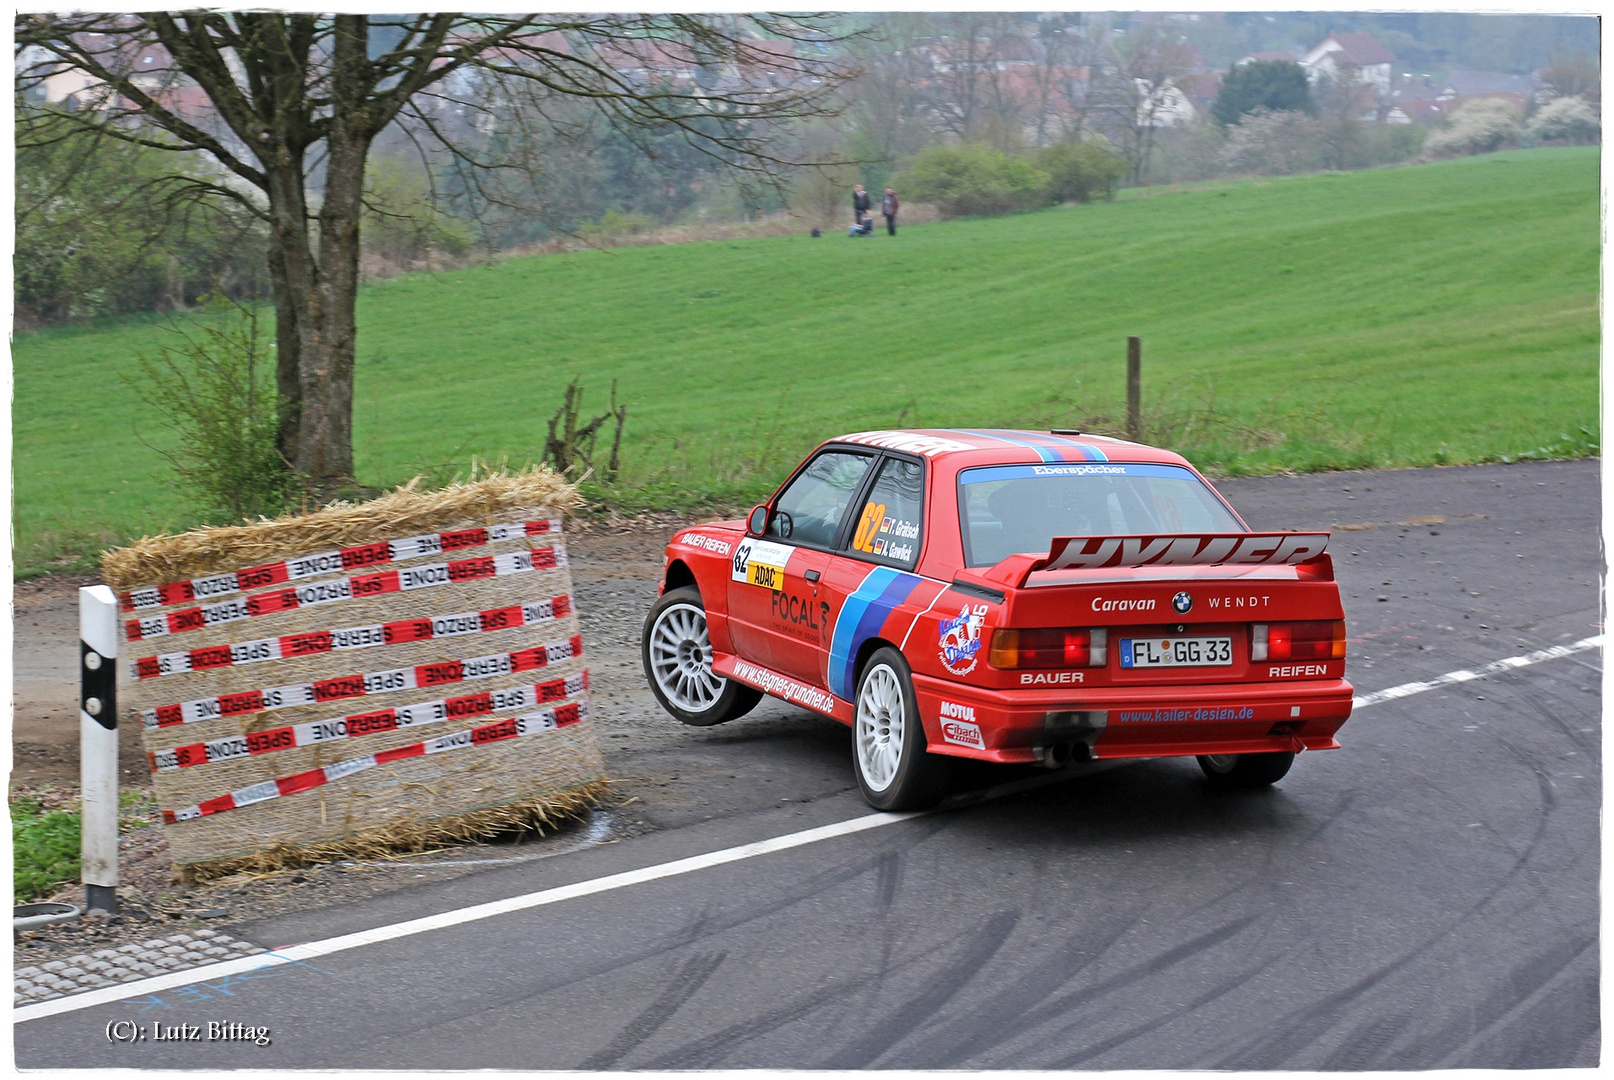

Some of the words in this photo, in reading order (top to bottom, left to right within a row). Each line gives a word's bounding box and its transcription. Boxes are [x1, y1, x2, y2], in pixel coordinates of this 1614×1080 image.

[1032, 465, 1127, 476] Eberspächer
[853, 502, 886, 554] 62
[681, 533, 706, 547] BAUER
[703, 538, 731, 555] REIFEN
[1046, 534, 1330, 569] HYMER
[293, 544, 396, 575] SPERRZONE
[733, 545, 751, 574] 62
[181, 573, 274, 598] SPERRZONE
[754, 565, 775, 587] ADAC
[282, 577, 384, 607] SPERRZONE
[1092, 597, 1156, 612] Caravan
[1209, 596, 1270, 608] WENDT
[176, 599, 260, 629] SPERRZONE
[772, 590, 818, 629] FOCAL
[413, 611, 508, 637] SPERRZONE
[291, 627, 393, 652] SPERRZONE
[1133, 643, 1160, 664] FL
[1174, 641, 1201, 662] GG
[1206, 640, 1230, 662] 33
[184, 643, 269, 668] SPERRZONE
[424, 656, 517, 683] SPERRZONE
[1020, 672, 1084, 684] BAUER
[1269, 665, 1327, 678] REIFEN
[303, 673, 405, 700] SPERRZONE
[733, 661, 834, 713] www.stegner-grundner.de
[194, 691, 283, 717] SPERRZONE
[432, 691, 525, 718] SPERRZONE
[940, 701, 976, 722] MOTUL
[1120, 707, 1254, 722] www.kailer-design.de
[311, 709, 413, 739] SPERRZONE
[943, 722, 979, 740] Eibach
[205, 731, 292, 759] SPERRZONE
